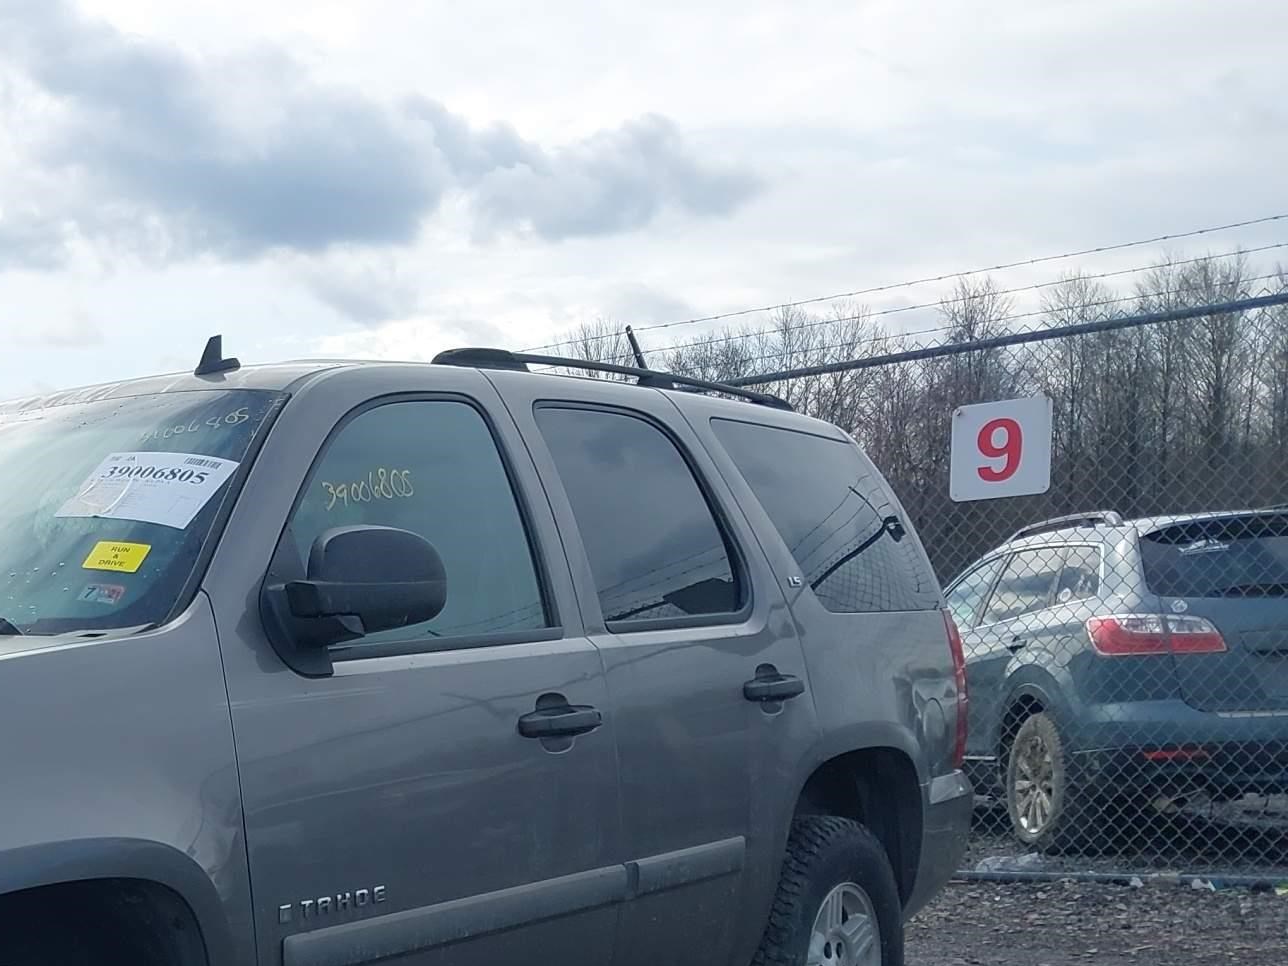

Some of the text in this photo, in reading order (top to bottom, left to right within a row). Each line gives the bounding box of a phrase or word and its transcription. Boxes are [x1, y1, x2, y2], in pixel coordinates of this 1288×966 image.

[977, 417, 1023, 482] 9
[100, 465, 210, 486] 39006805
[321, 467, 414, 511] 39006805
[98, 559, 127, 567] DRIVE
[84, 587, 97, 599] 7
[300, 885, 386, 918] TAHOE
